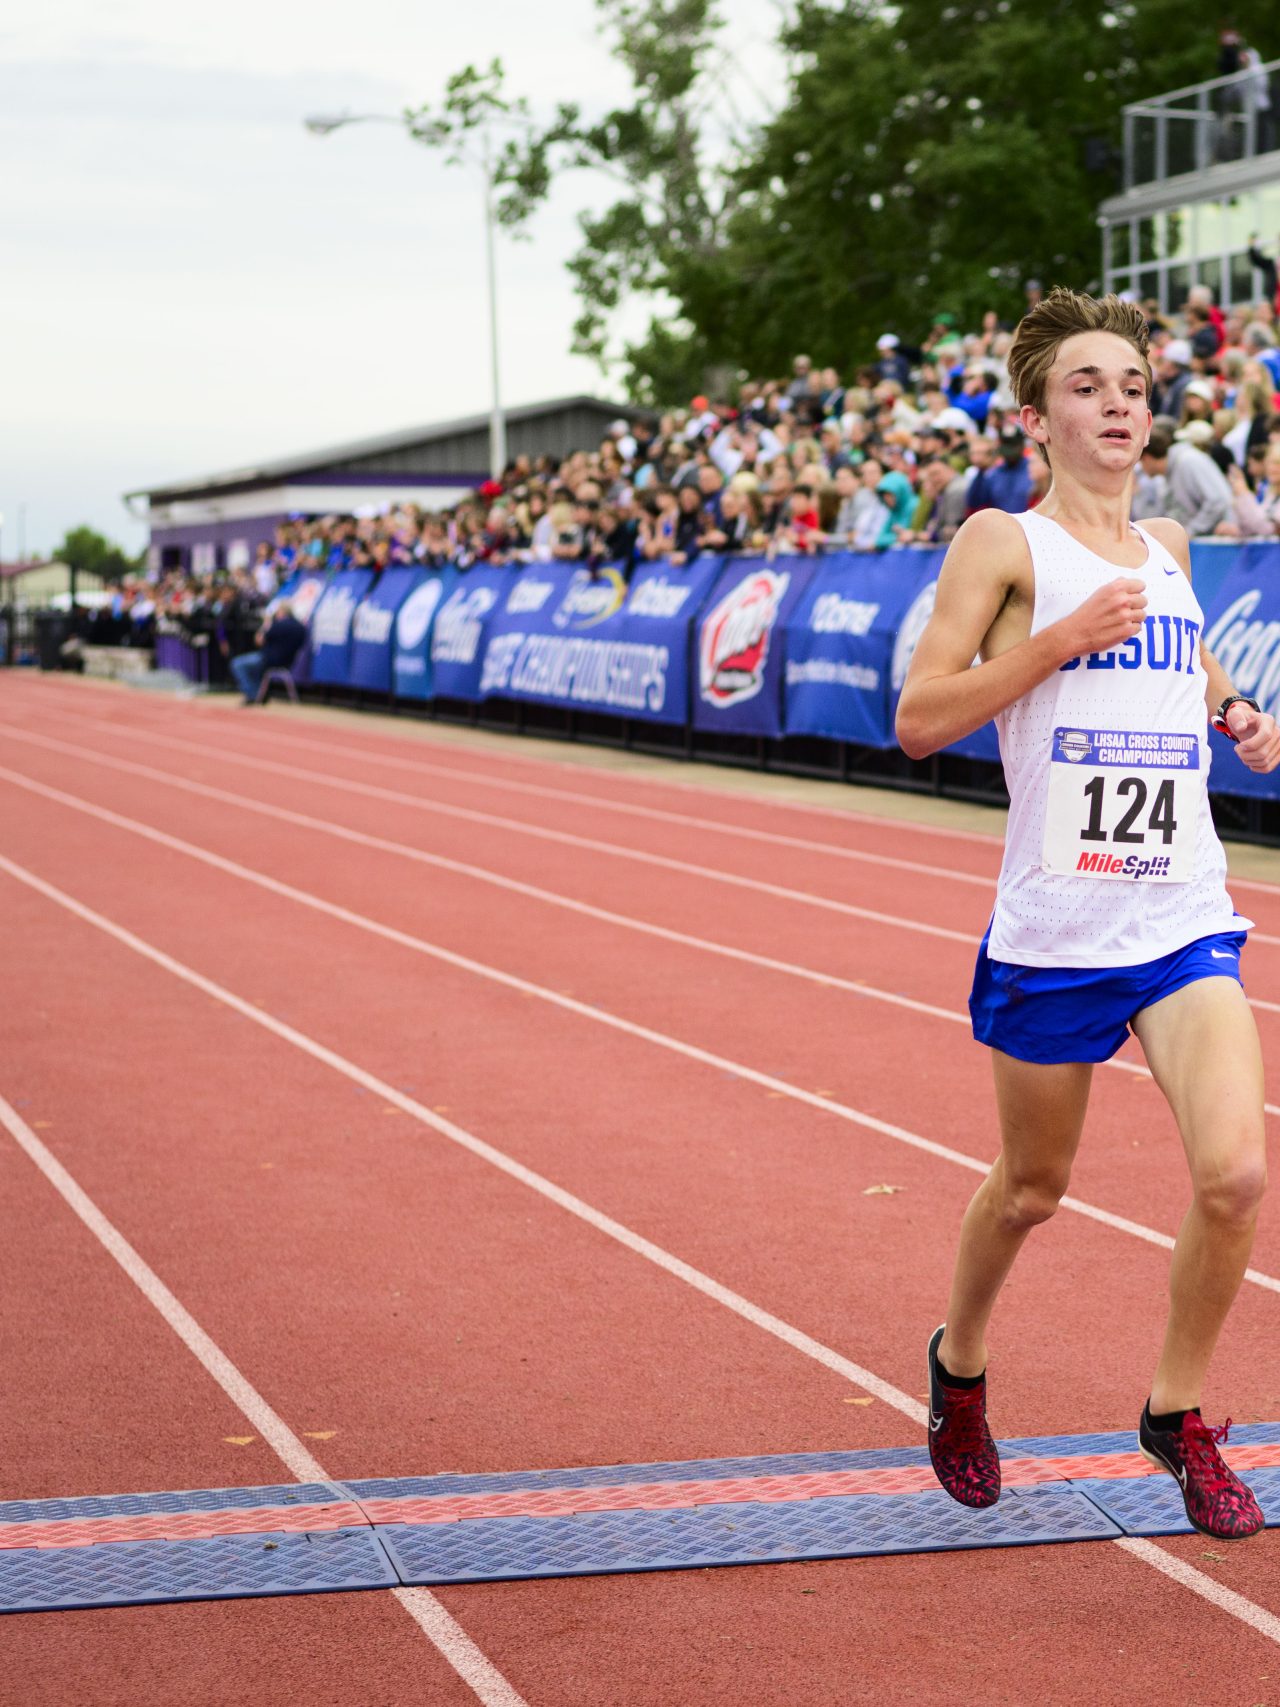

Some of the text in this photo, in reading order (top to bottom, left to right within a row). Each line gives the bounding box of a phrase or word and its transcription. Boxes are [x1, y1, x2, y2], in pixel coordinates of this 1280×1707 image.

[1059, 615, 1200, 675] SUIT
[1093, 732, 1126, 748] LHSAA
[1128, 734, 1159, 750] CROSS
[1161, 736, 1195, 751] COUNTRY
[1098, 748, 1189, 766] CHAMPIONSHIPS
[1080, 776, 1177, 844] 124
[1076, 851, 1171, 879] MileSplit
